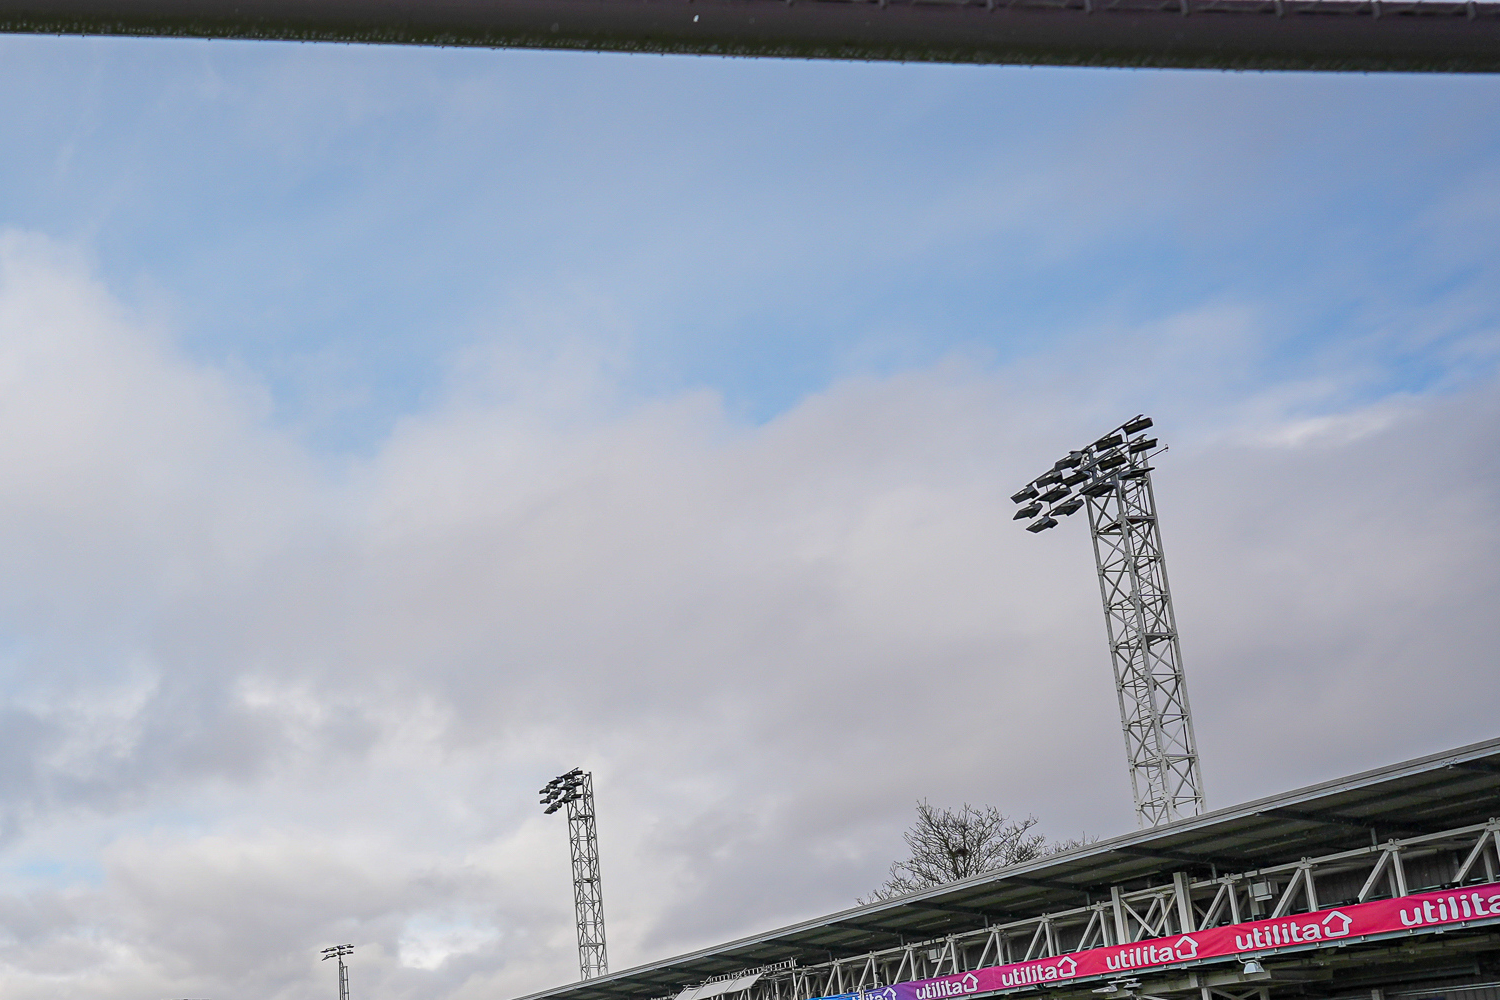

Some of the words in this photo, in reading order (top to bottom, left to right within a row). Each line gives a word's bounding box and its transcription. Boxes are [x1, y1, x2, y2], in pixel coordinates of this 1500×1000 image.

[1236, 922, 1321, 950] utilita
[1106, 946, 1174, 970] utilita
[1002, 964, 1058, 986] utilita
[916, 980, 963, 1000] utilita
